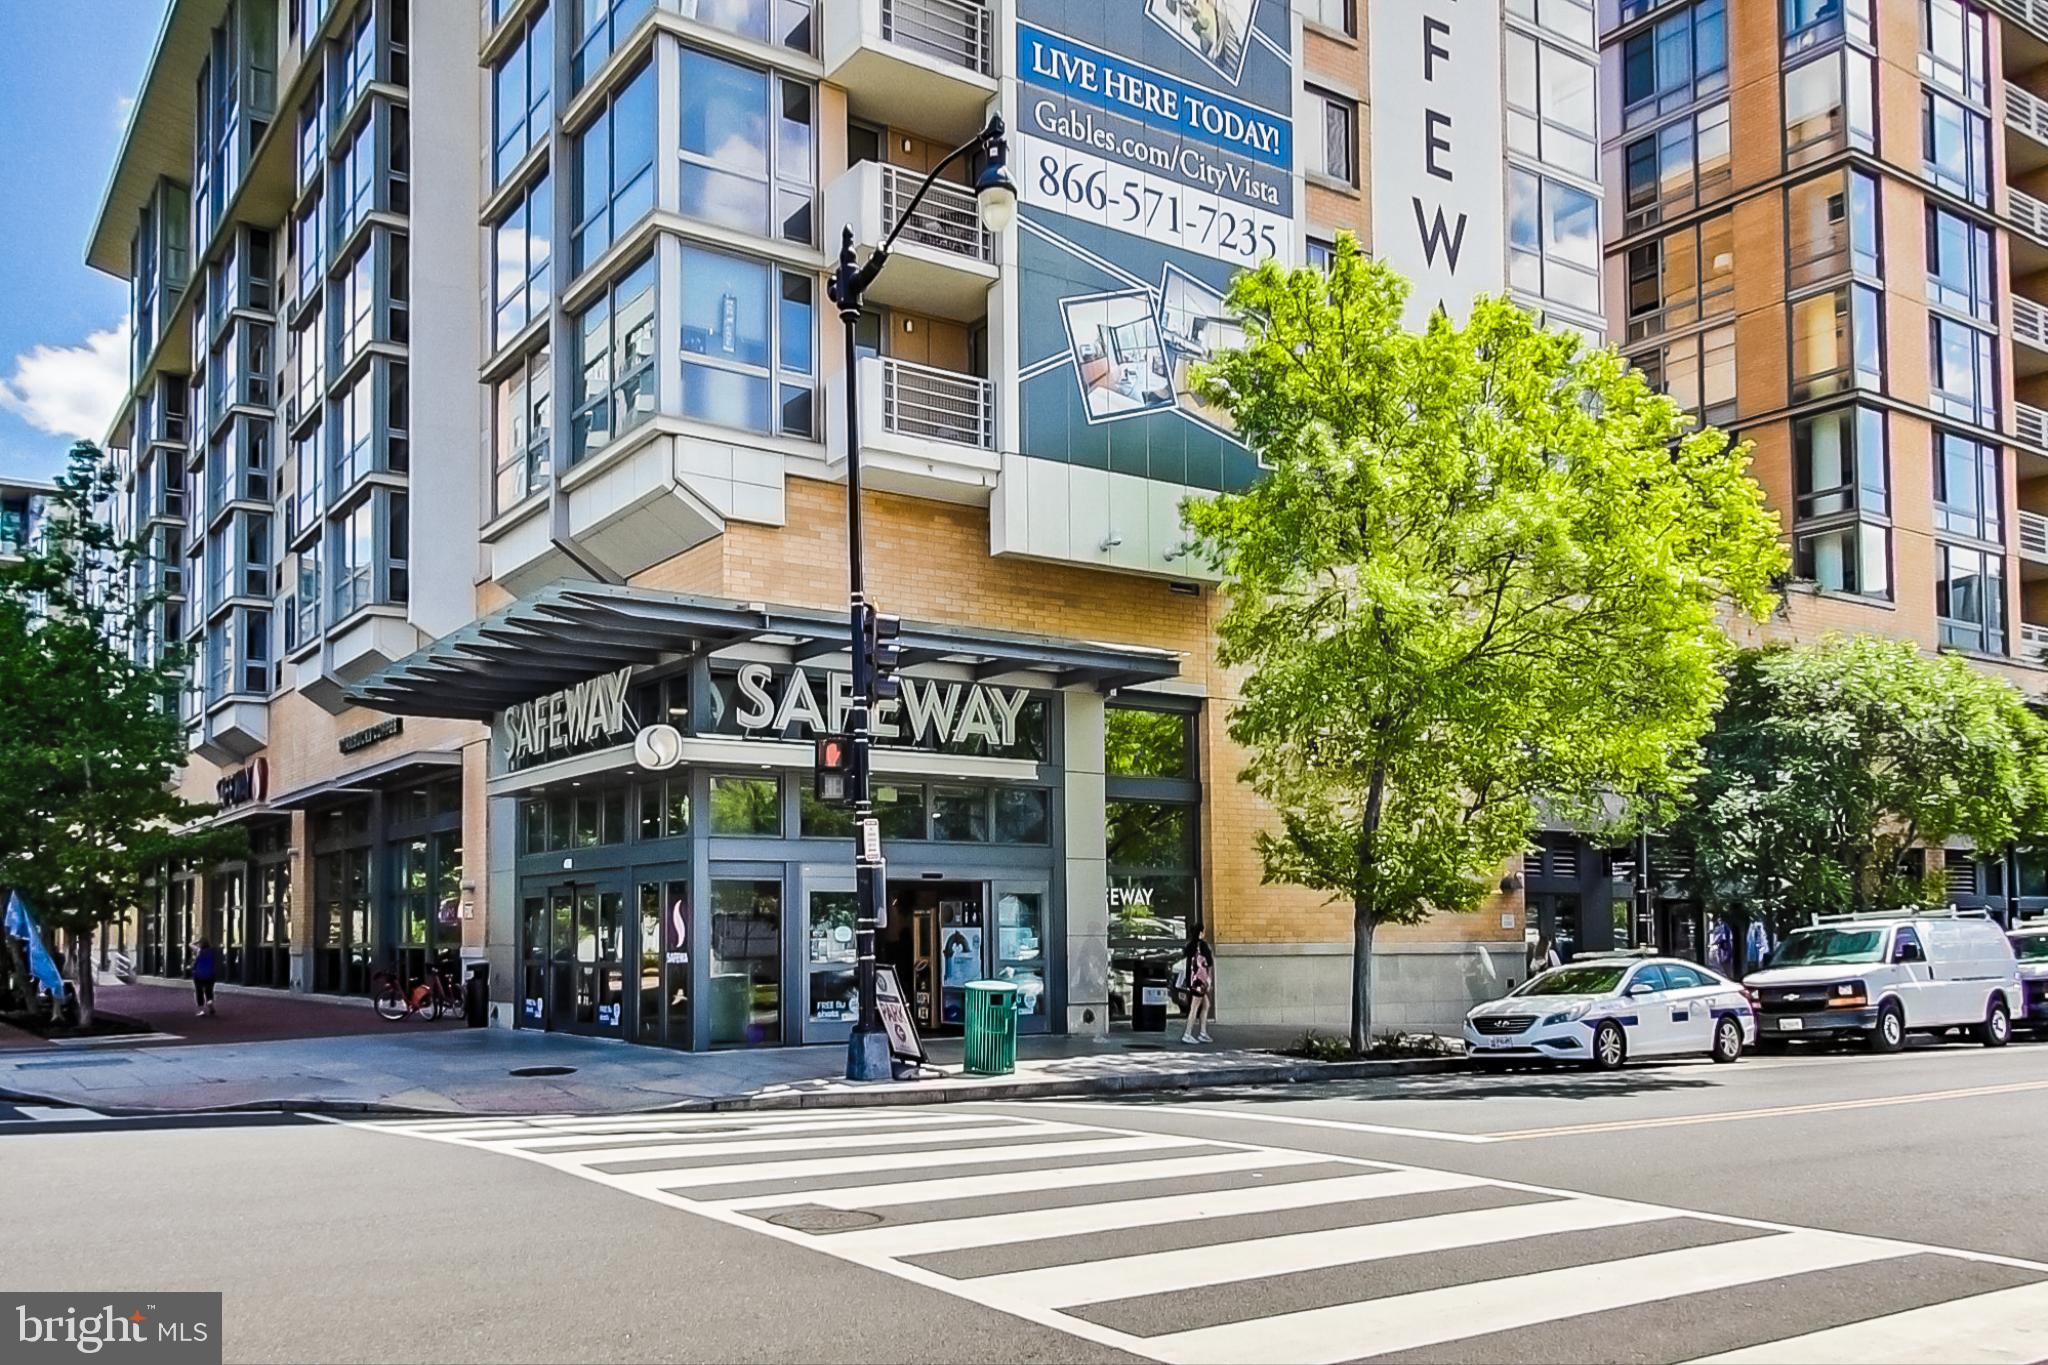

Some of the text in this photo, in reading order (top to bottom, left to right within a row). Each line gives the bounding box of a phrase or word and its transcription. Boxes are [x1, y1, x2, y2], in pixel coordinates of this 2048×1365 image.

[1032, 41, 1280, 155] LIVE HERE TODAY!
[1034, 100, 1280, 205] Gables.com/CityVista
[1039, 155, 1277, 259] 866-571-7235
[503, 666, 632, 759] SAFEWAY
